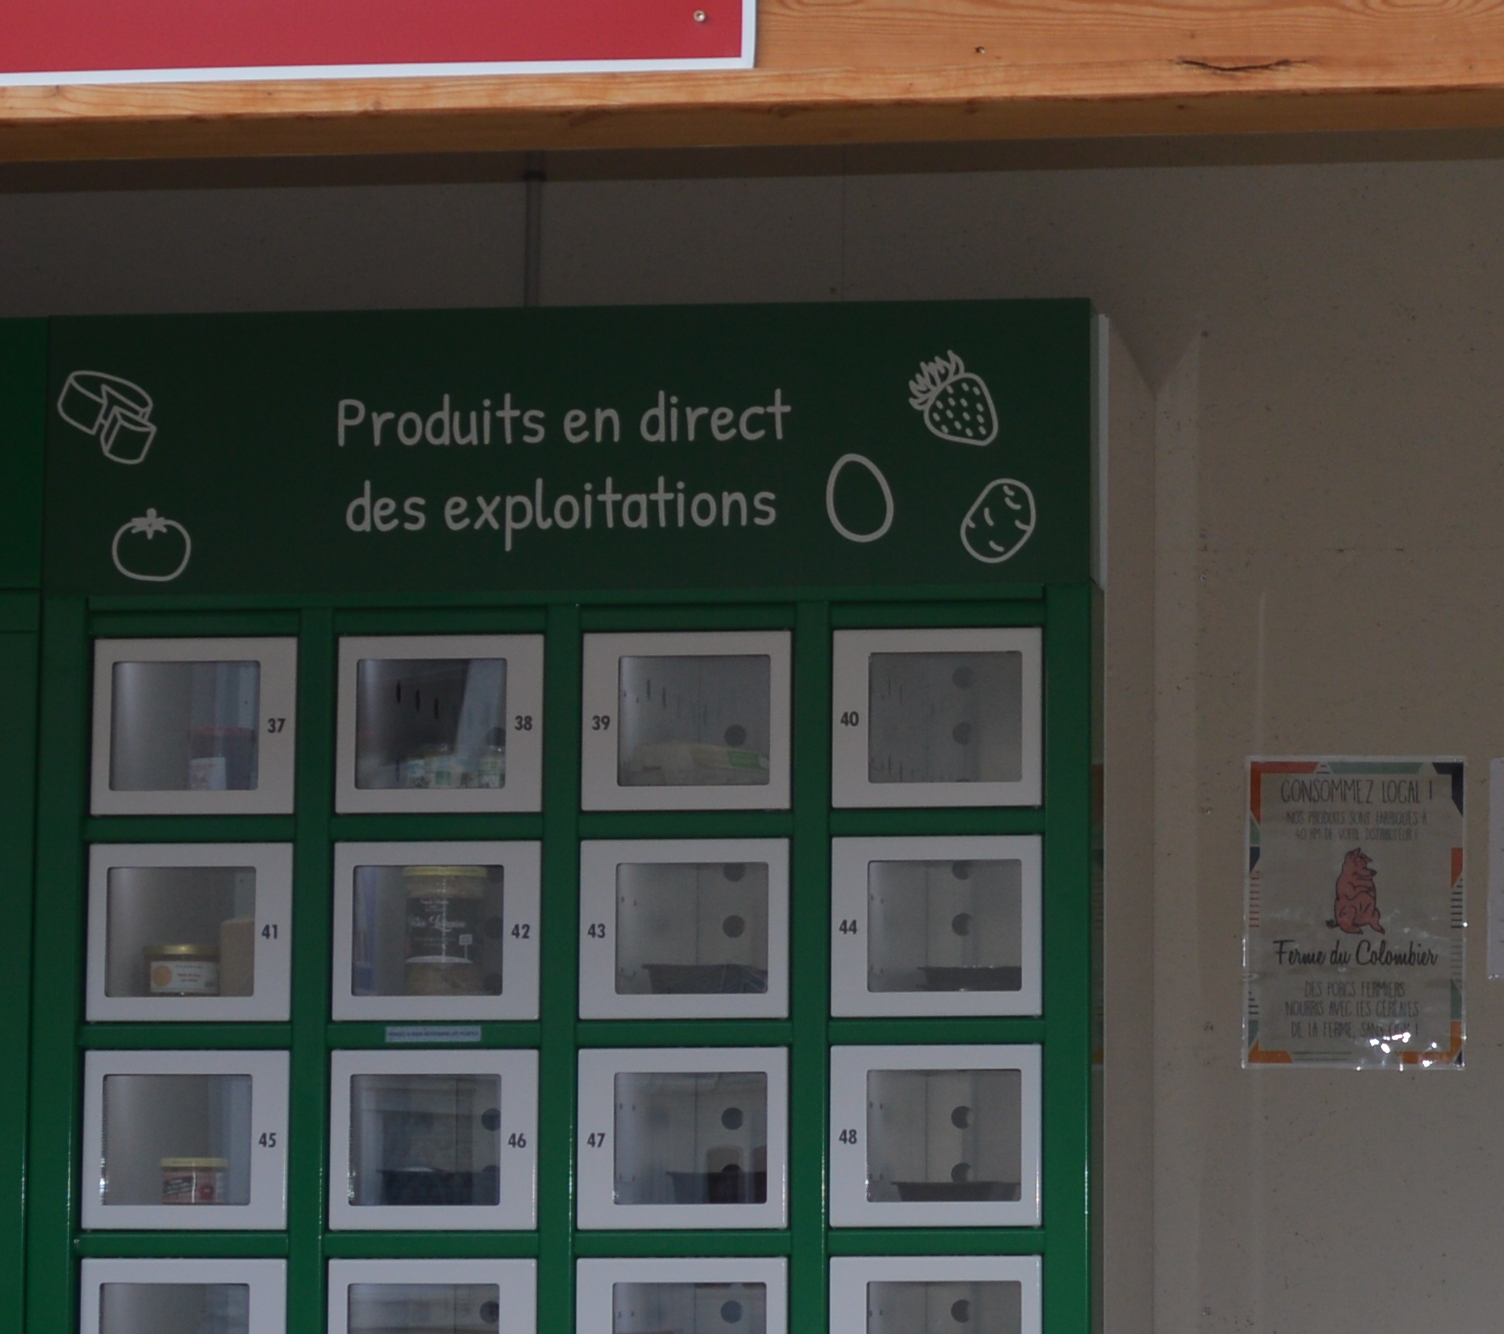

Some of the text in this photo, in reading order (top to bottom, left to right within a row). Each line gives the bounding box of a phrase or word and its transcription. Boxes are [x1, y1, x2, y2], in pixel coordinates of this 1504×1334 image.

[338, 389, 791, 446] Produits en direct
[346, 476, 776, 551] des exploitations
[267, 717, 286, 734] 37
[514, 714, 533, 732] 38
[592, 714, 611, 731] 39
[840, 710, 860, 727] 40
[1280, 778, 1374, 804] CONSOMMEZ
[1381, 779, 1421, 804] LOCAL
[1308, 810, 1345, 825] PRODUITS
[1349, 810, 1370, 825] SONT
[1324, 827, 1332, 841] DE
[1338, 827, 1360, 841] VOTRE
[261, 924, 278, 940] 41
[511, 923, 531, 940] 42
[587, 923, 606, 939] 43
[839, 919, 858, 935] 44
[1273, 939, 1438, 965] Ferme du Colombier
[1304, 980, 1406, 998] DES PORCS FERMIERS
[1285, 1000, 1325, 1018] NOURRIS
[1329, 1000, 1352, 1018] AVEC
[1356, 1000, 1371, 1018] LES
[1291, 1021, 1303, 1038] DE
[1308, 1021, 1318, 1038] LA
[1361, 1021, 1384, 1038] SANS
[258, 1132, 277, 1148] 45
[507, 1132, 527, 1149] 46
[587, 1132, 606, 1148] 47
[838, 1128, 858, 1145] 48
